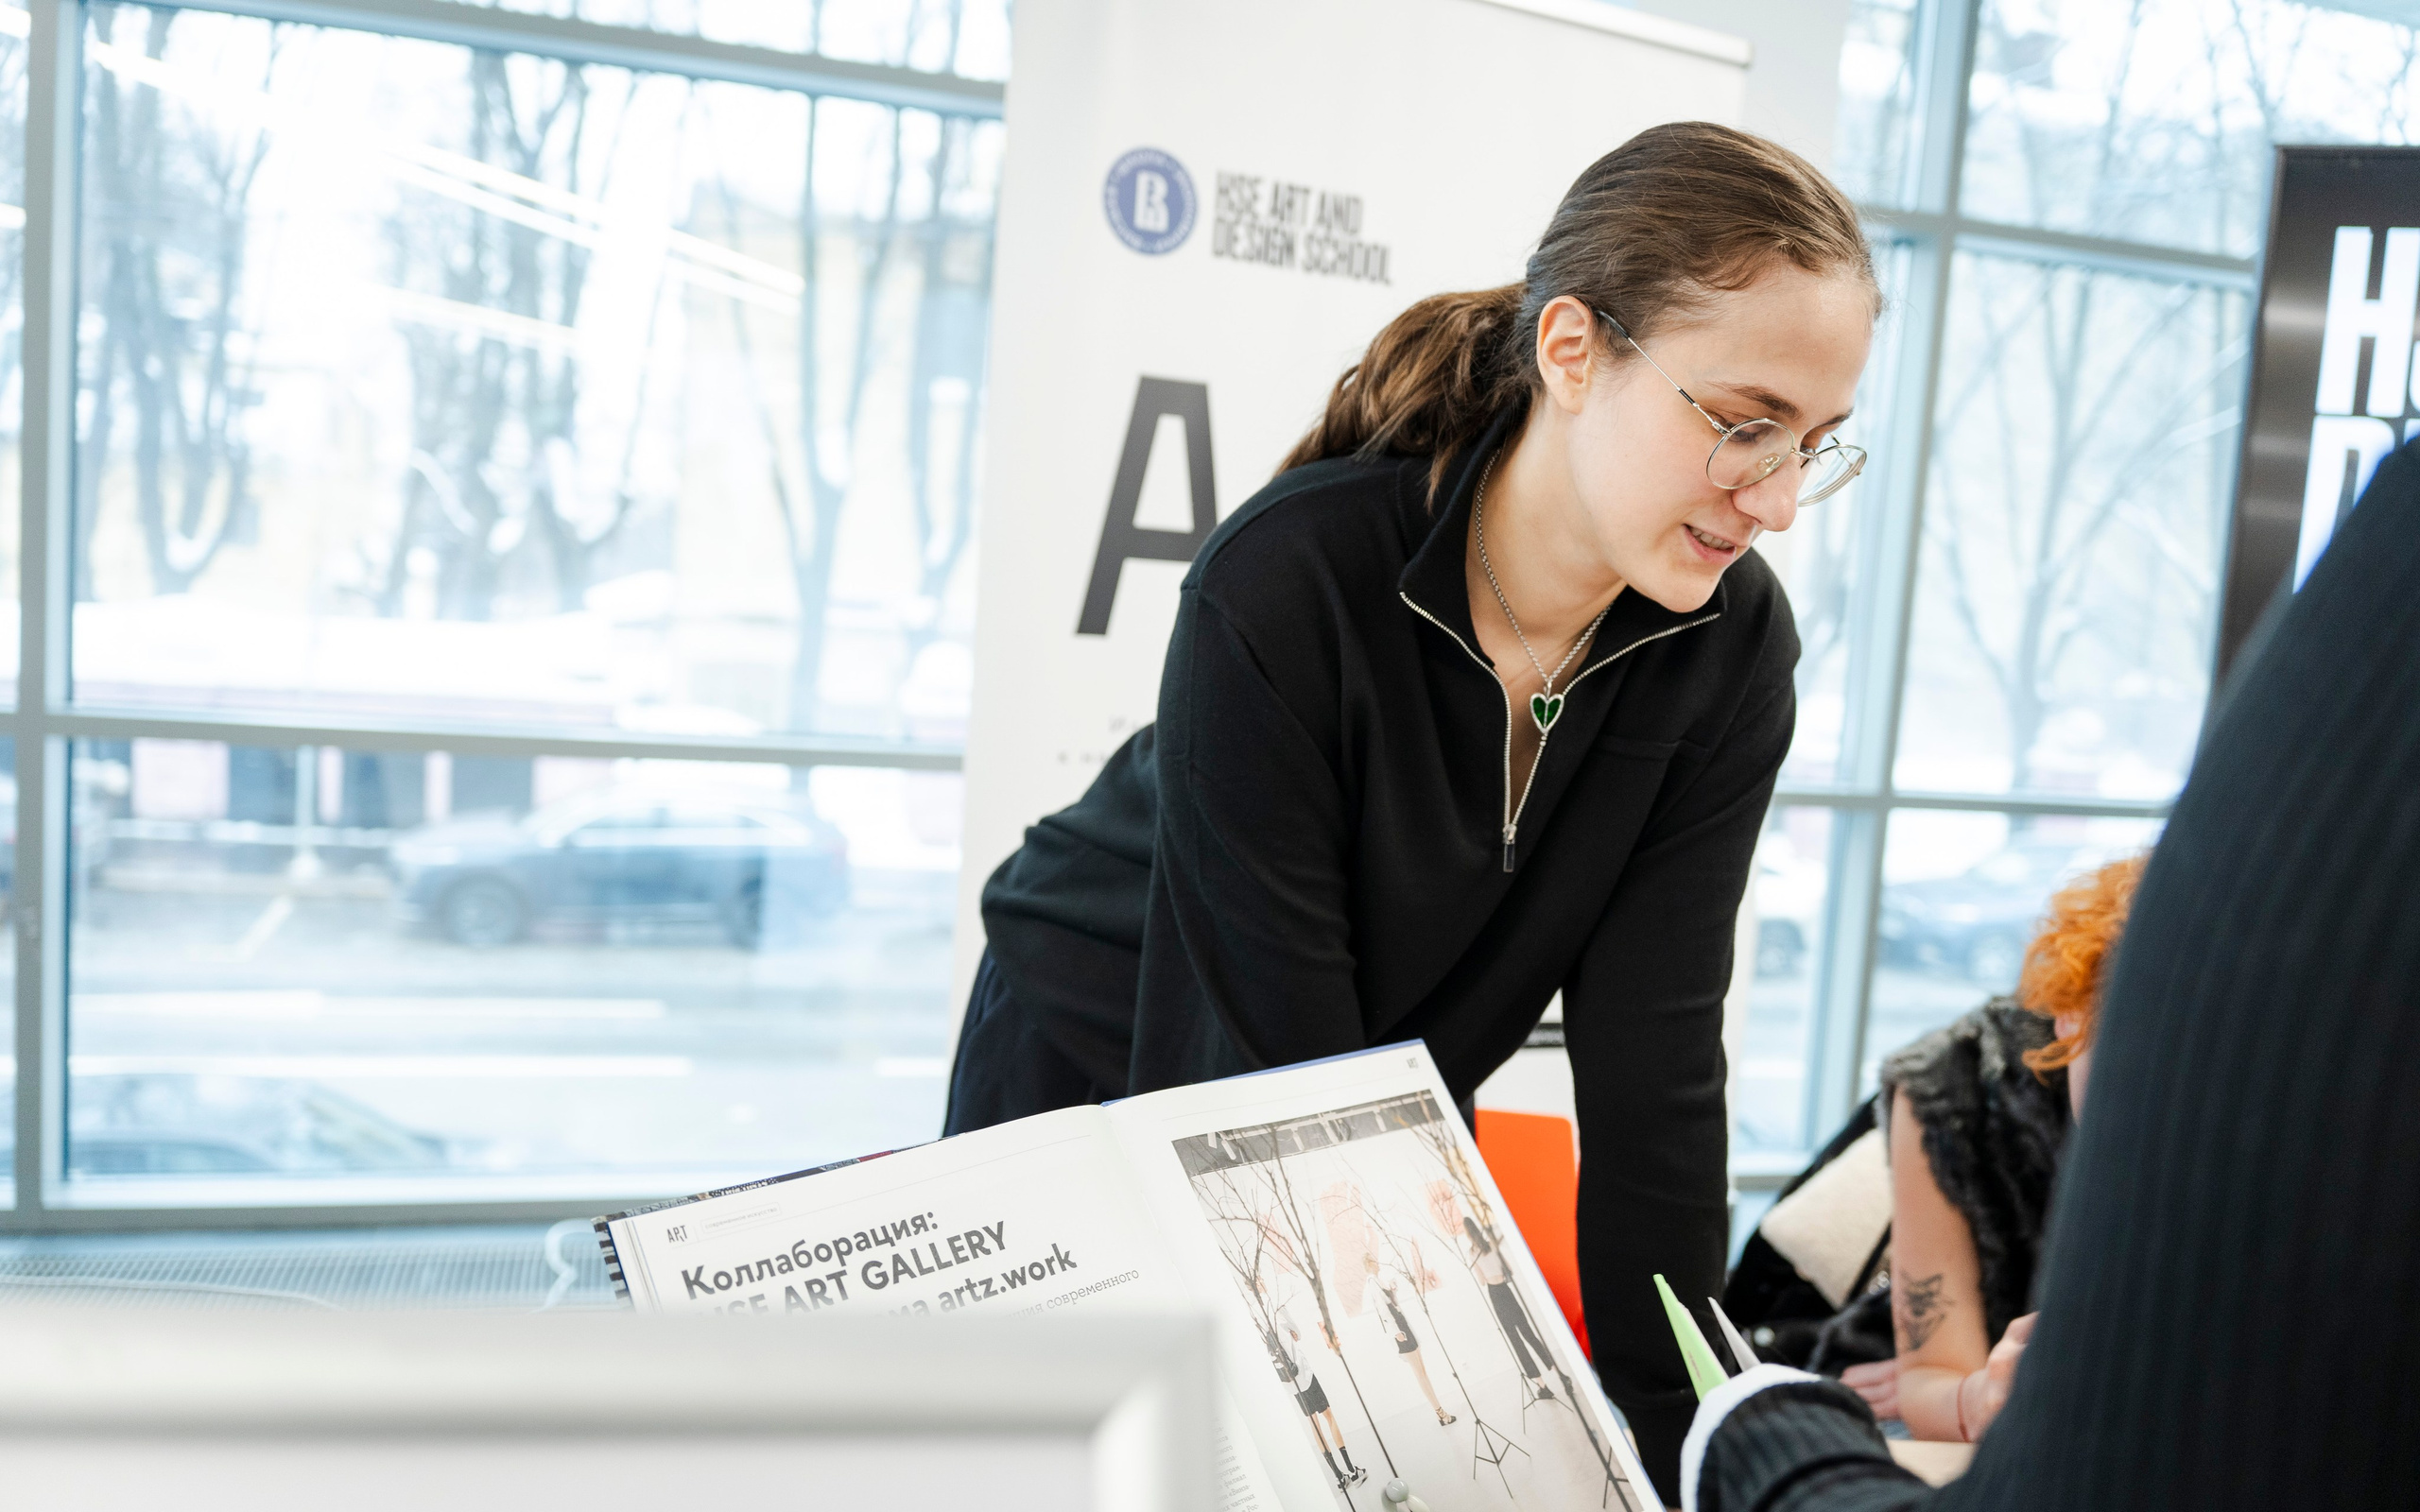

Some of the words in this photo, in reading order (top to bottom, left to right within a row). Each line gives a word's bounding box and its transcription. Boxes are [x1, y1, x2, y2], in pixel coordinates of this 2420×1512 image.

[1216, 170, 1262, 215] HSE
[1270, 181, 1309, 226] ART
[1316, 192, 1363, 235] AND
[1213, 216, 1296, 269] DESIGN
[1302, 232, 1392, 285] SCHOOL
[666, 1225, 687, 1244] ART
[681, 1211, 939, 1300] Коллаборация:
[784, 1269, 849, 1315] ART
[861, 1220, 1006, 1291] GALLERY
[938, 1243, 1078, 1314] artz.work
[1046, 1268, 1140, 1309] современного
